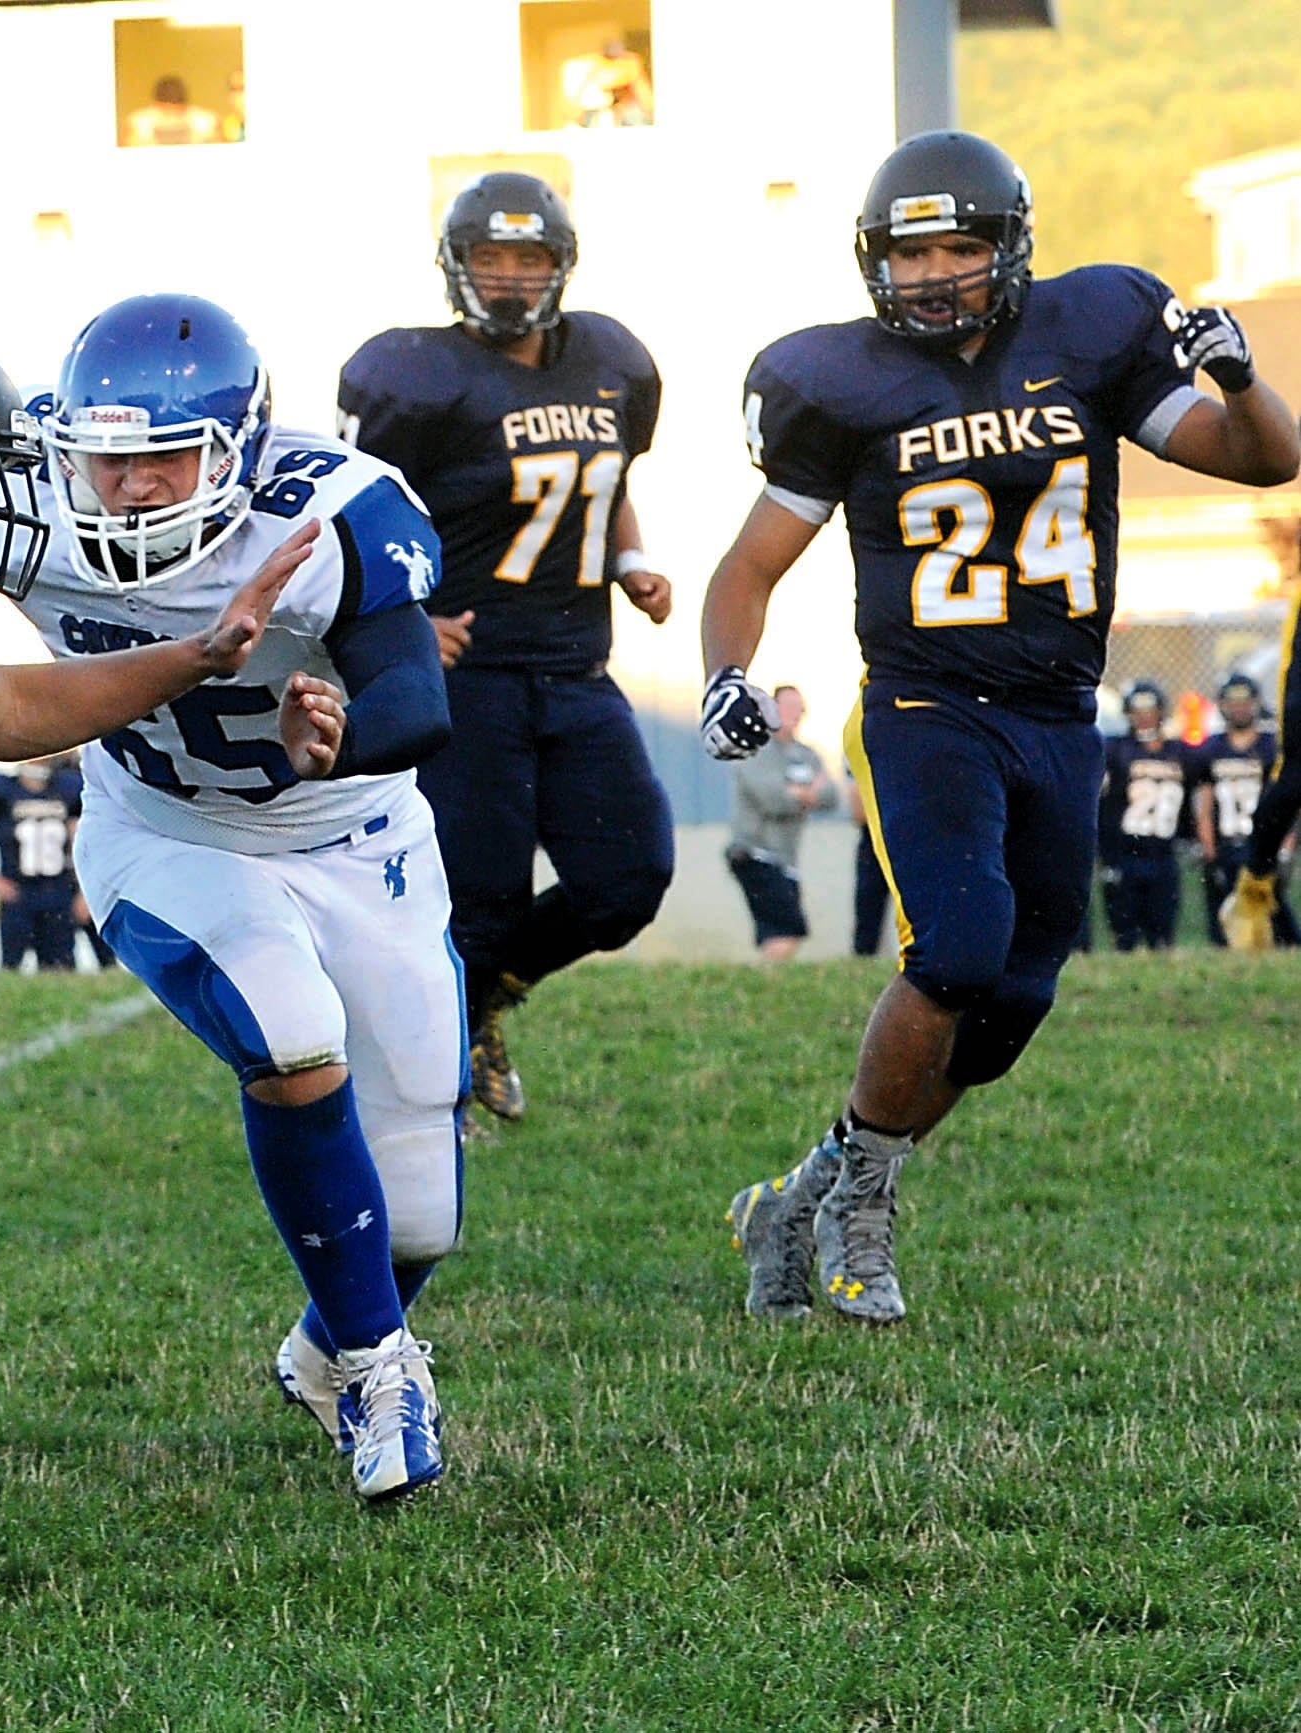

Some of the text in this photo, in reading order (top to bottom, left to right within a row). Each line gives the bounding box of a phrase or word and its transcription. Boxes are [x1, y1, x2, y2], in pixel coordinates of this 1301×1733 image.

[90, 410, 132, 423] Riddell
[502, 404, 619, 449] FORKS
[898, 405, 1085, 473] FORKS
[493, 450, 624, 588] 71
[898, 455, 1098, 628] 24
